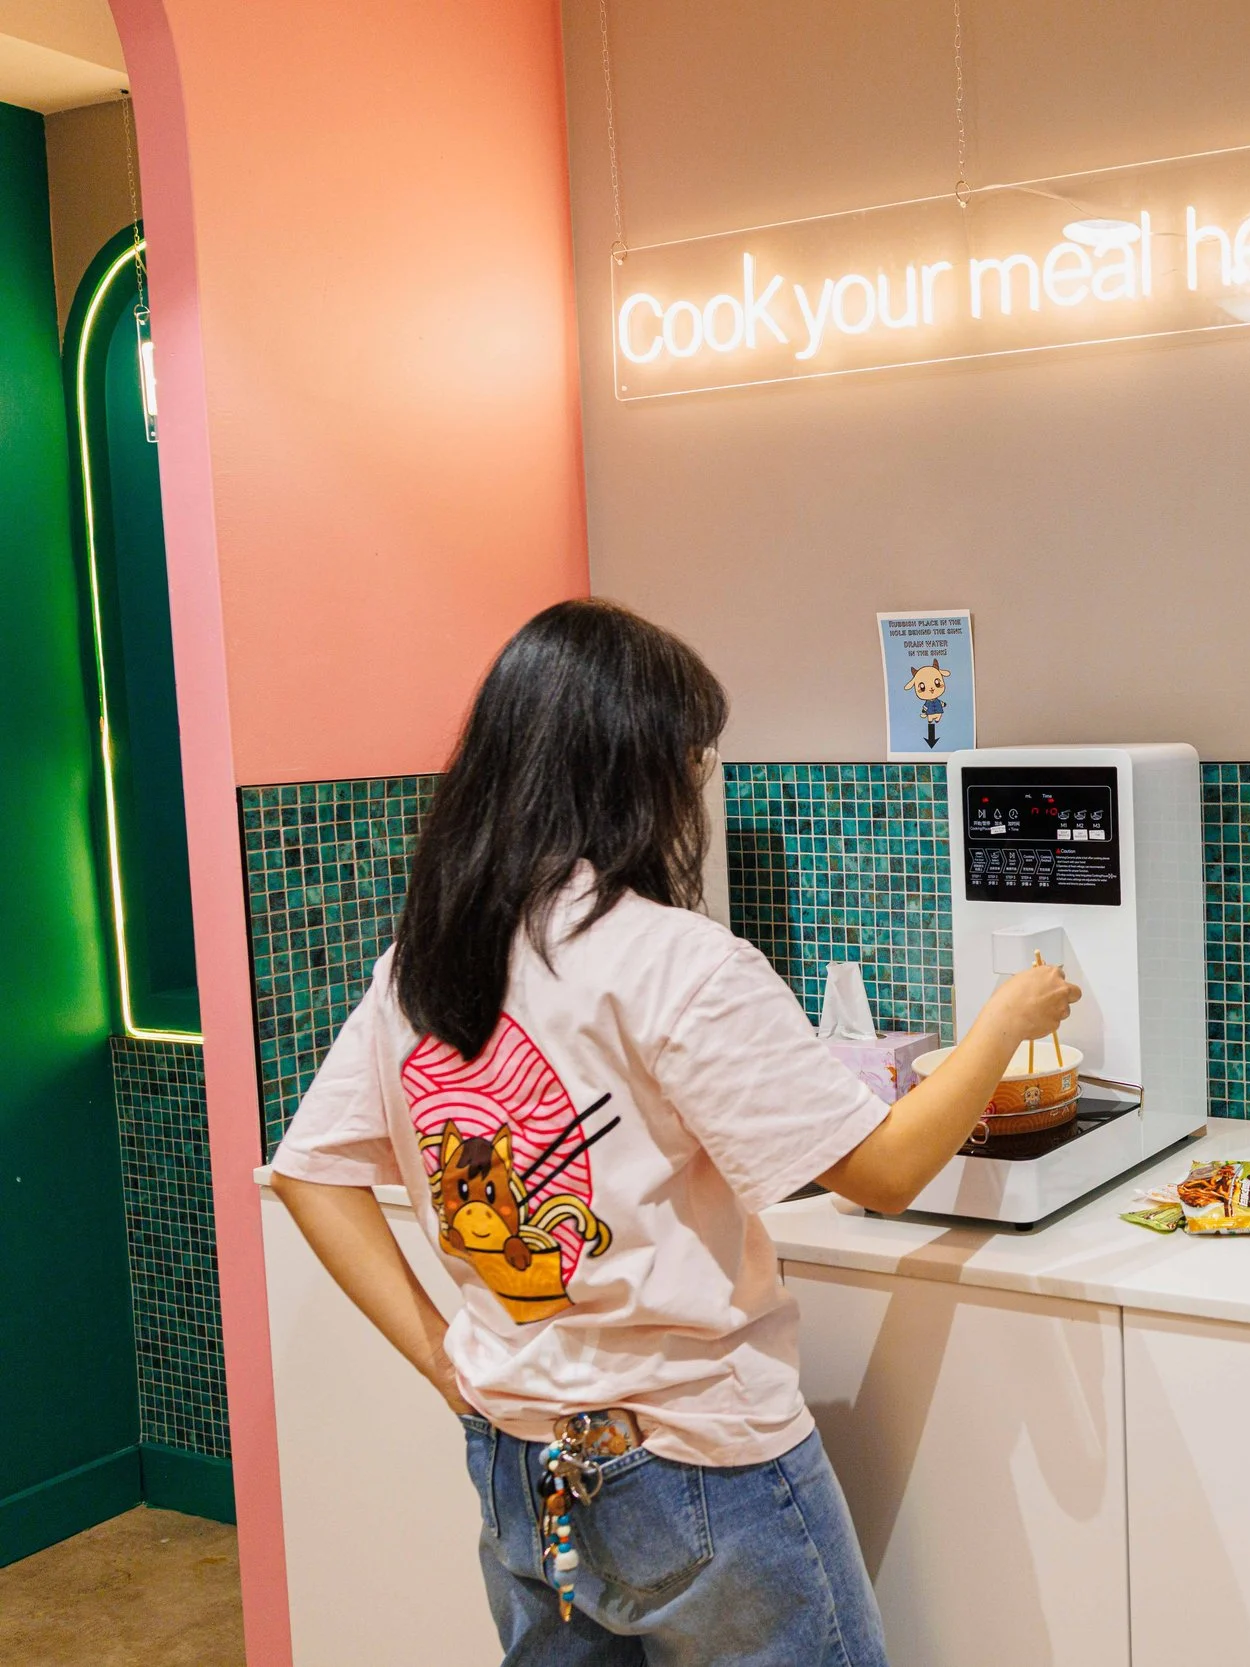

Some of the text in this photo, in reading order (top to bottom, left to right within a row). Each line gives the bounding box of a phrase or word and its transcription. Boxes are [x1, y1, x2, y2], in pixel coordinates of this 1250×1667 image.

[618, 252, 790, 364] Cook
[793, 260, 951, 359] your
[970, 210, 1150, 320] meal
[904, 640, 924, 648] DRAIN
